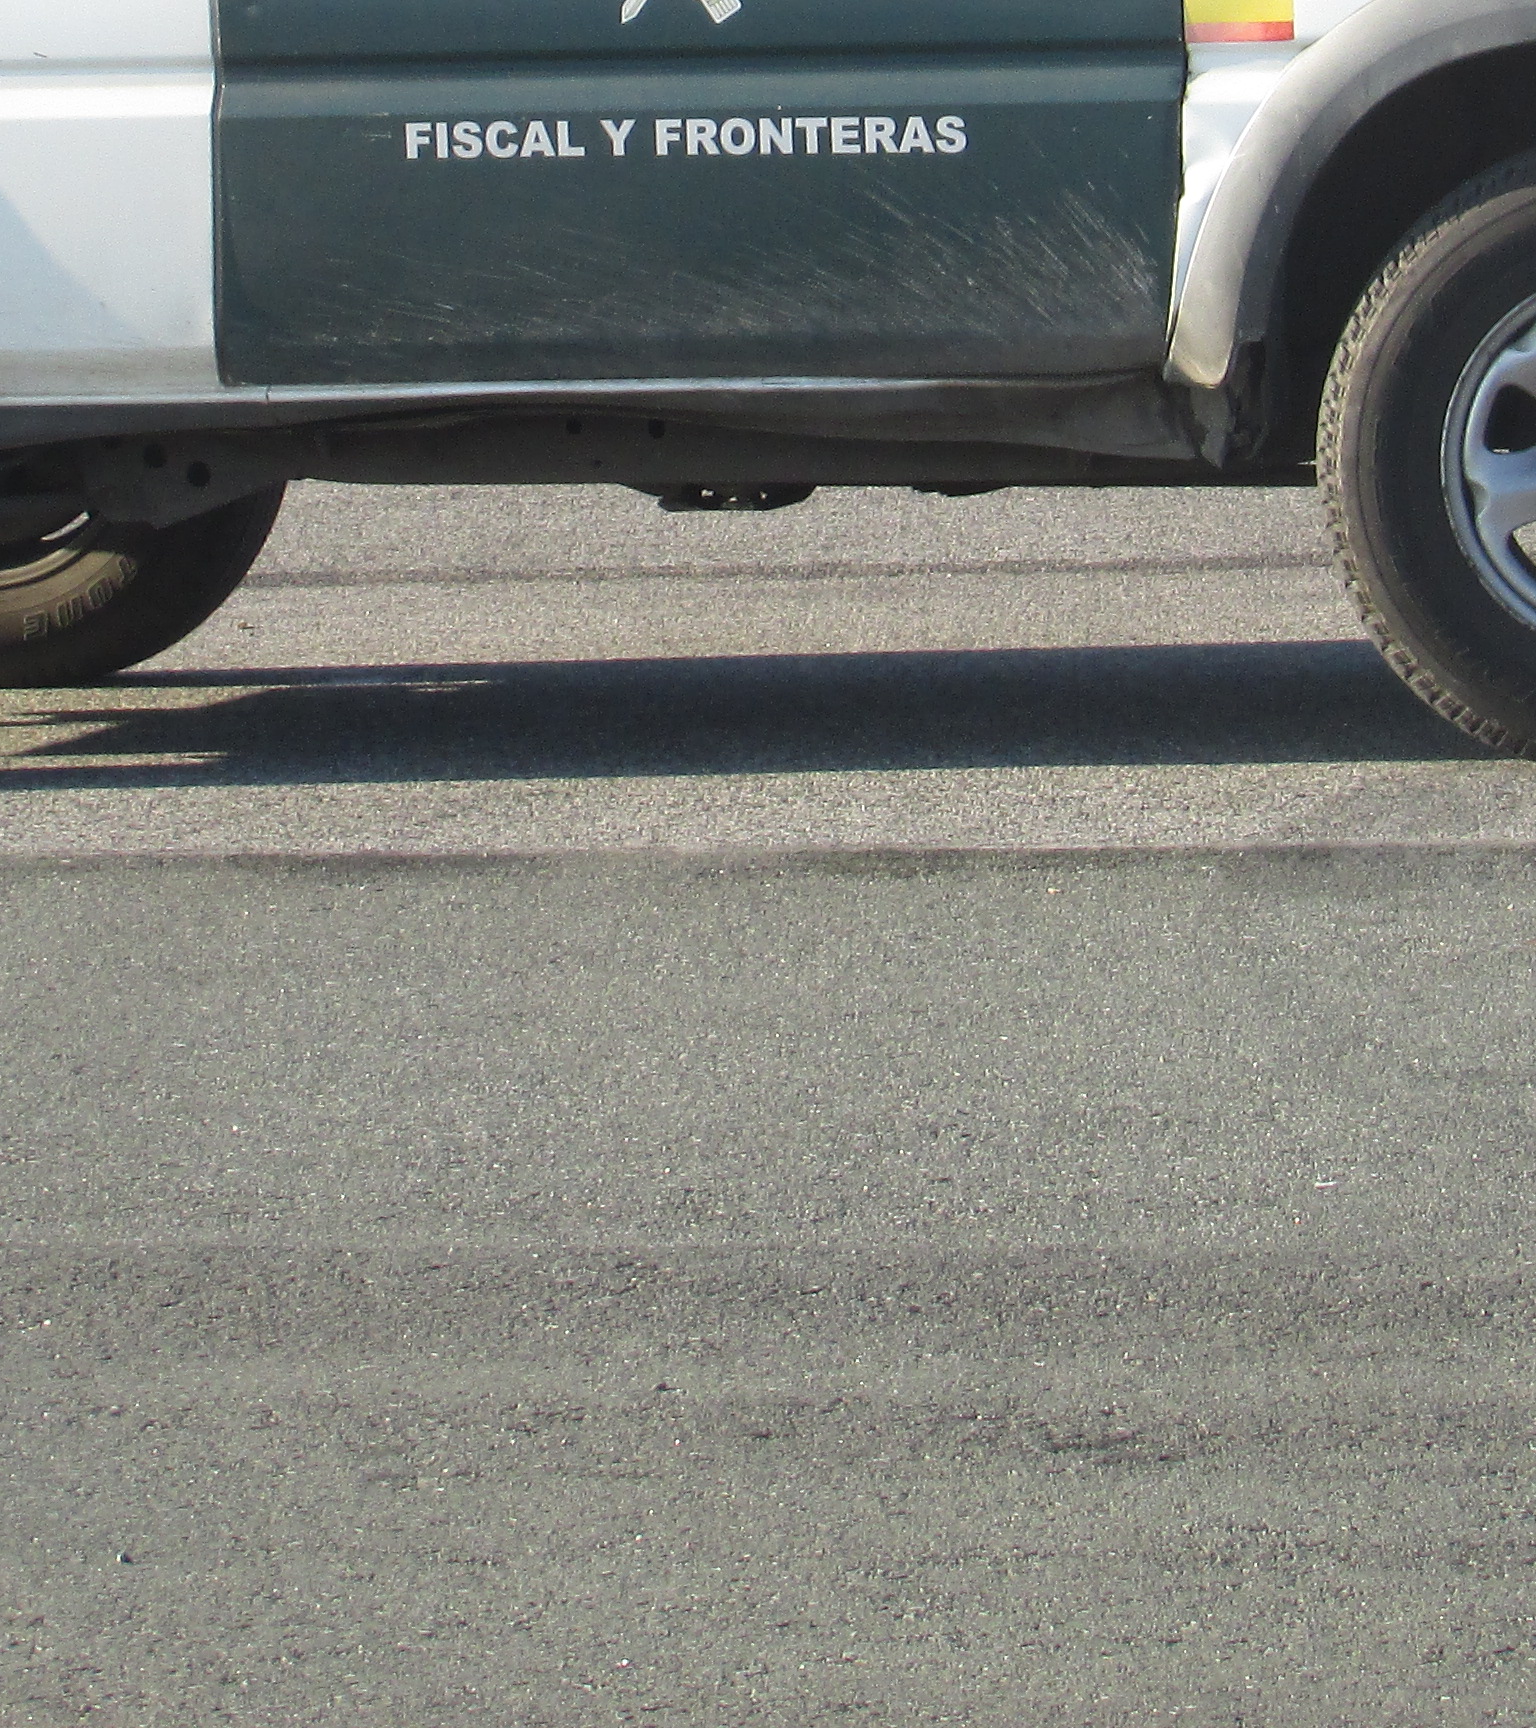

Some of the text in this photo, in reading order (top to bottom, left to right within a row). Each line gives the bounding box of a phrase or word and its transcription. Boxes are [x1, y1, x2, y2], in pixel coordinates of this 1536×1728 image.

[404, 115, 968, 160] FISCAL Y FRONTERAS
